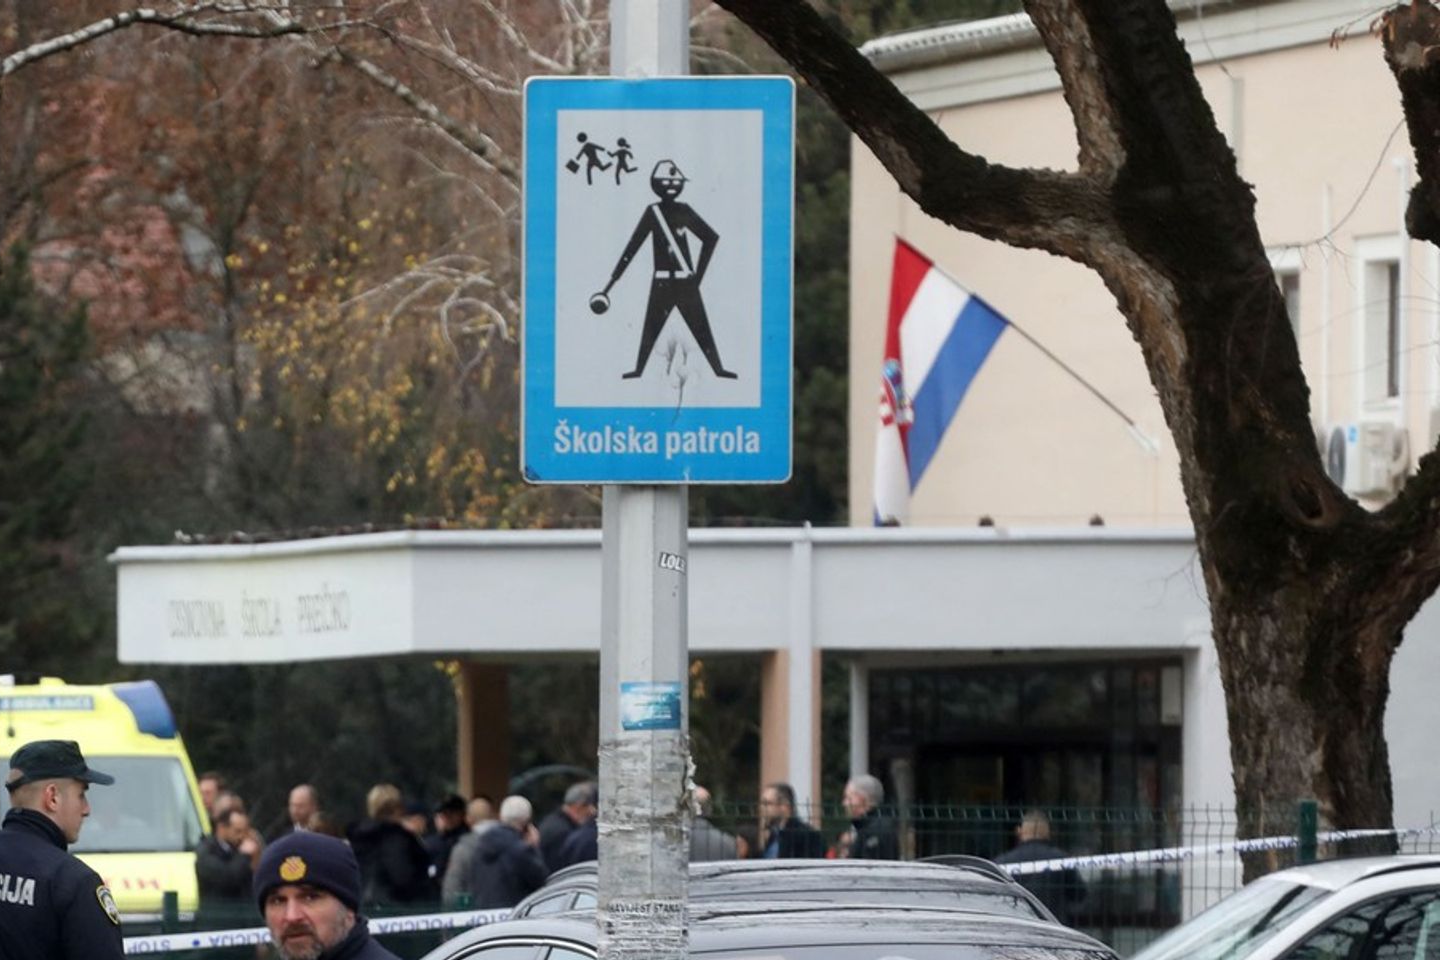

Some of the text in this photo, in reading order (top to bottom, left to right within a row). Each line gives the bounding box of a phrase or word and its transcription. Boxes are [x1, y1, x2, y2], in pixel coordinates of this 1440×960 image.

[554, 418, 760, 460] Školska patrola
[208, 932, 271, 947] OLICIJA
